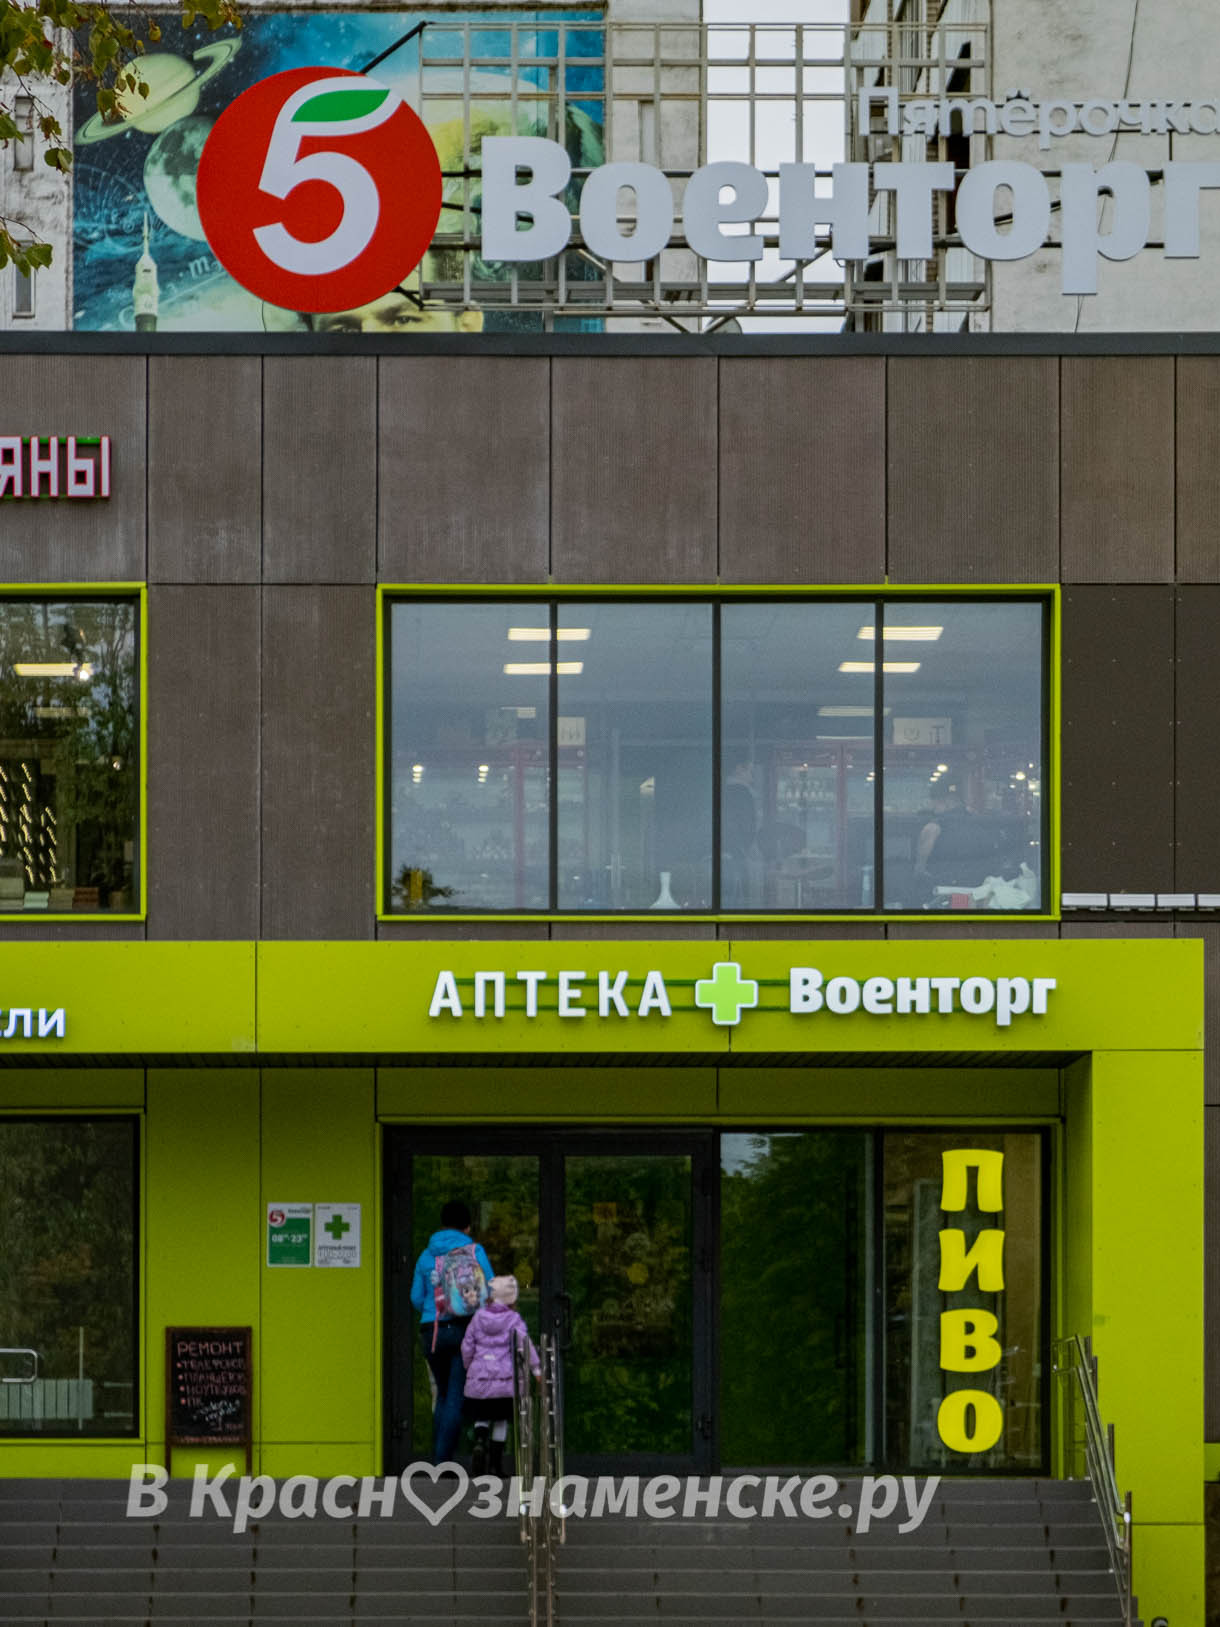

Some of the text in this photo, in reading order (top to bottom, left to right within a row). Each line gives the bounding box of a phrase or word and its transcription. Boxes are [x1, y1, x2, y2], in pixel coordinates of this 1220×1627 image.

[252, 76, 404, 276] 5
[0, 1006, 67, 1038] ли
[428, 966, 1058, 1027] АПТЕКА Военторг
[937, 1147, 1006, 1454] ПИВО
[176, 1340, 244, 1358] РЕМОНТ
